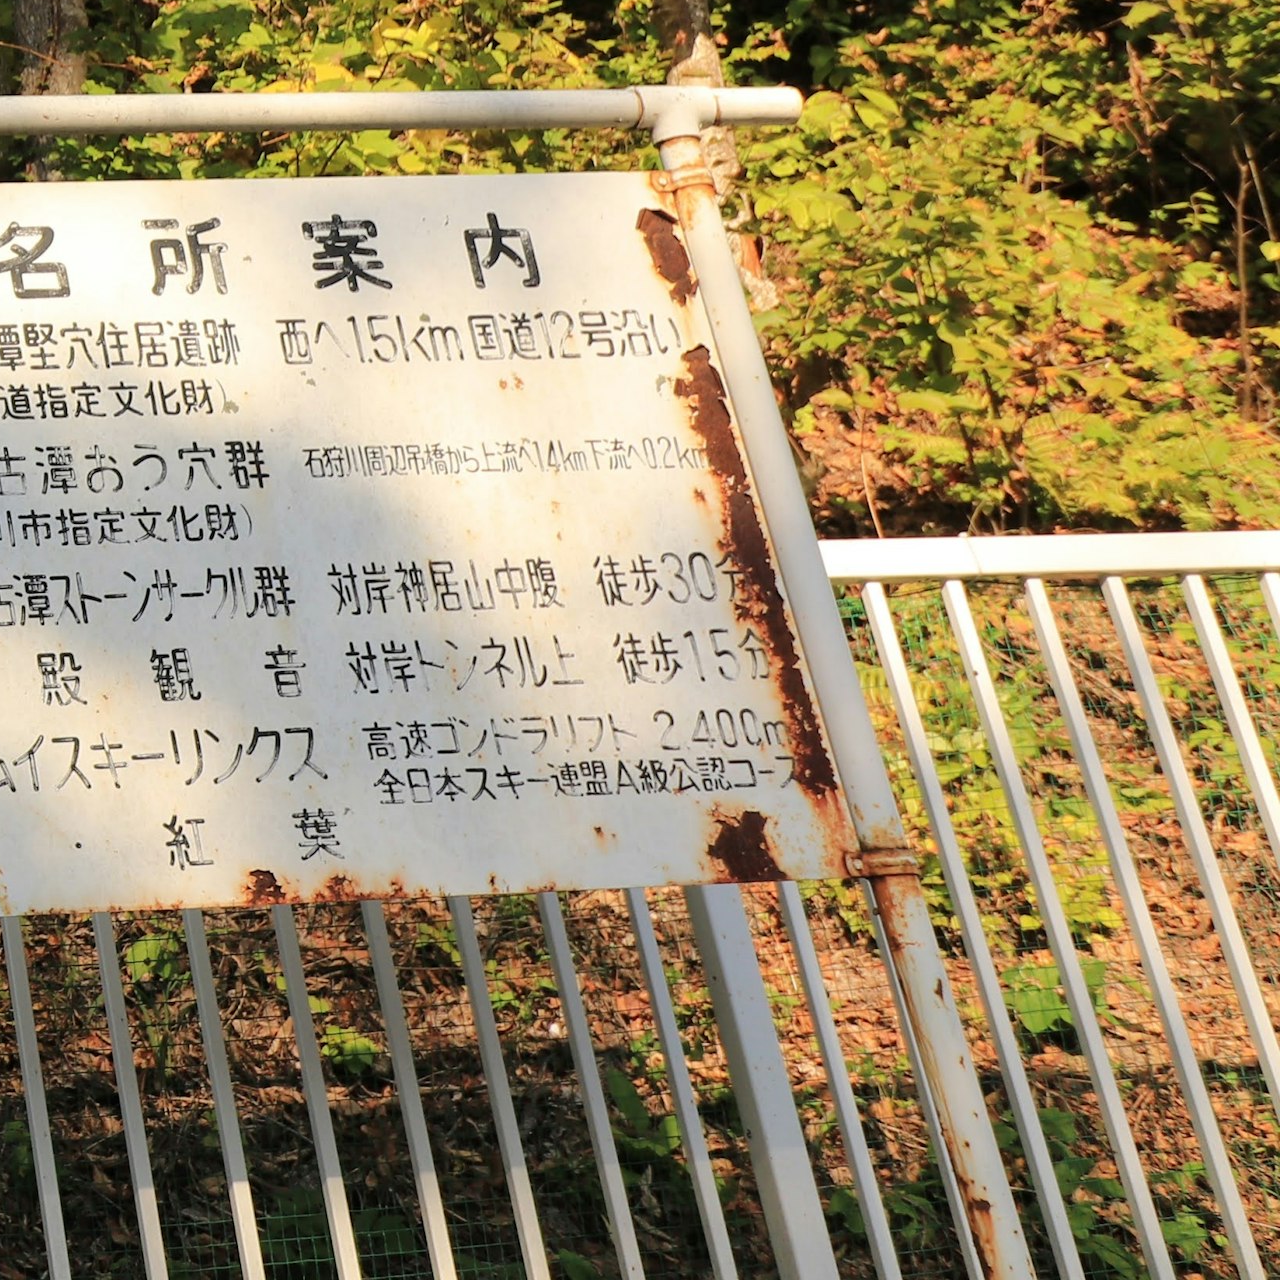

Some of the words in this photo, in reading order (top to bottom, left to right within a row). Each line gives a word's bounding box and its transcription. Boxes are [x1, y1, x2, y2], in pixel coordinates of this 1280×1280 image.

[345, 634, 584, 695] 対岸トンネル上
